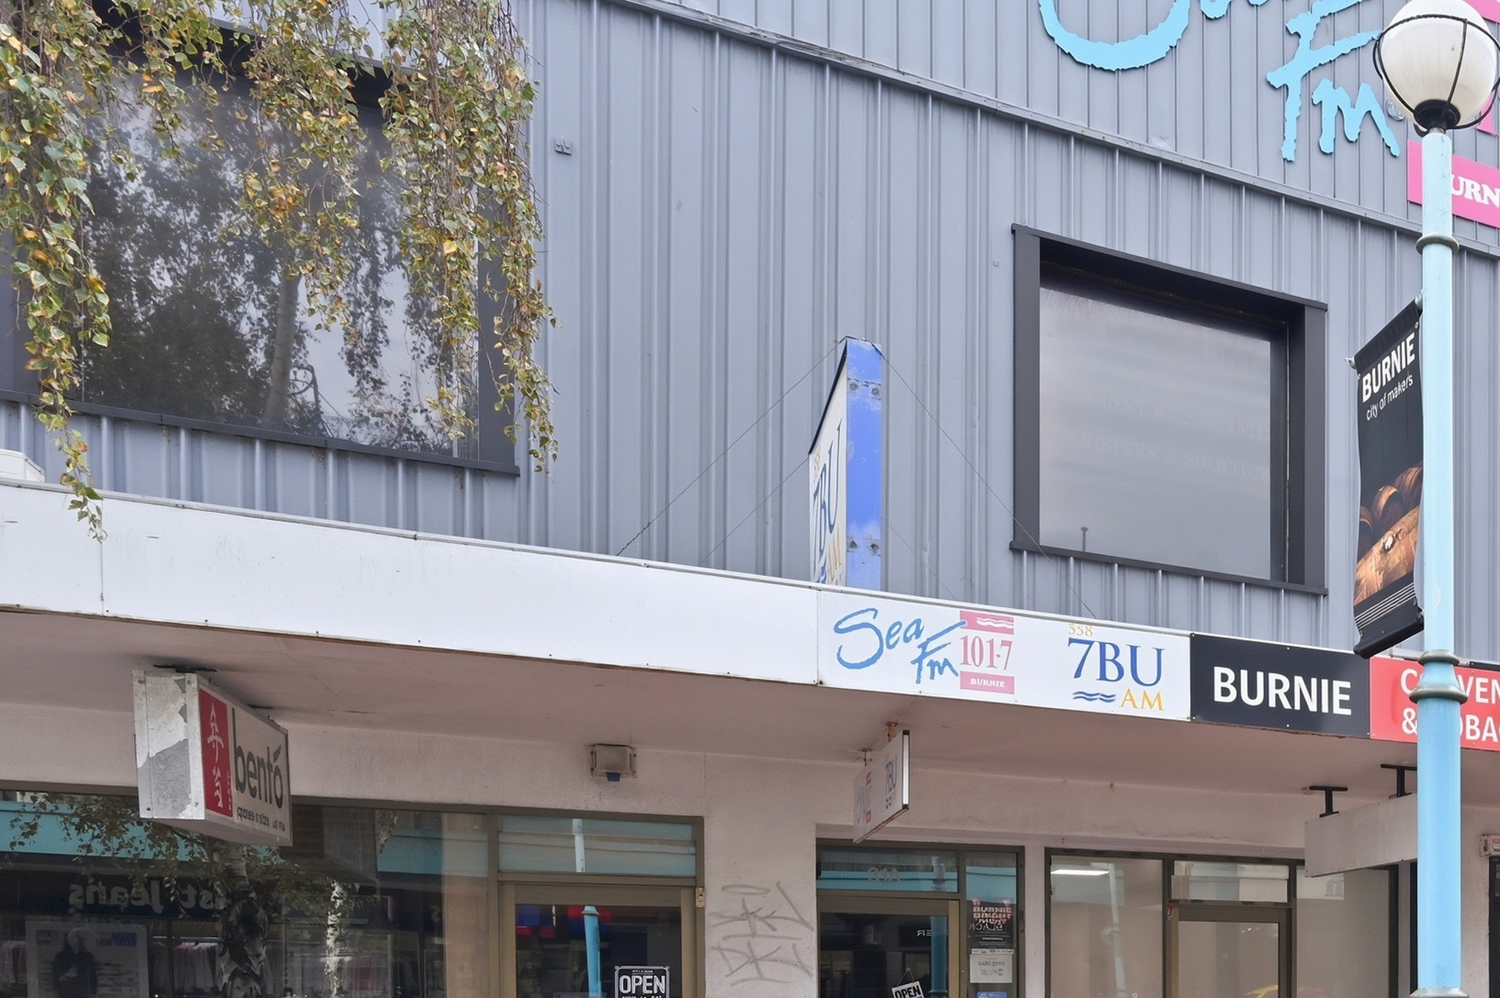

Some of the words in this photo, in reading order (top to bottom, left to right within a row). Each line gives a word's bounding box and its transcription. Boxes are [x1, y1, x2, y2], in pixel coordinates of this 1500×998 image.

[1362, 332, 1416, 403] BURNIE
[1366, 403, 1378, 421] city
[1379, 392, 1387, 410] of
[1387, 374, 1414, 404] makers
[833, 607, 923, 670] Sea
[911, 620, 967, 685] Fm
[1068, 623, 1094, 637] 558
[970, 678, 1006, 688] BURNIE
[1067, 637, 1165, 687] 7BU
[1119, 688, 1165, 712] AM
[1213, 666, 1352, 715] BURNIE
[1402, 708, 1418, 734] &
[619, 975, 665, 994] OPEN
